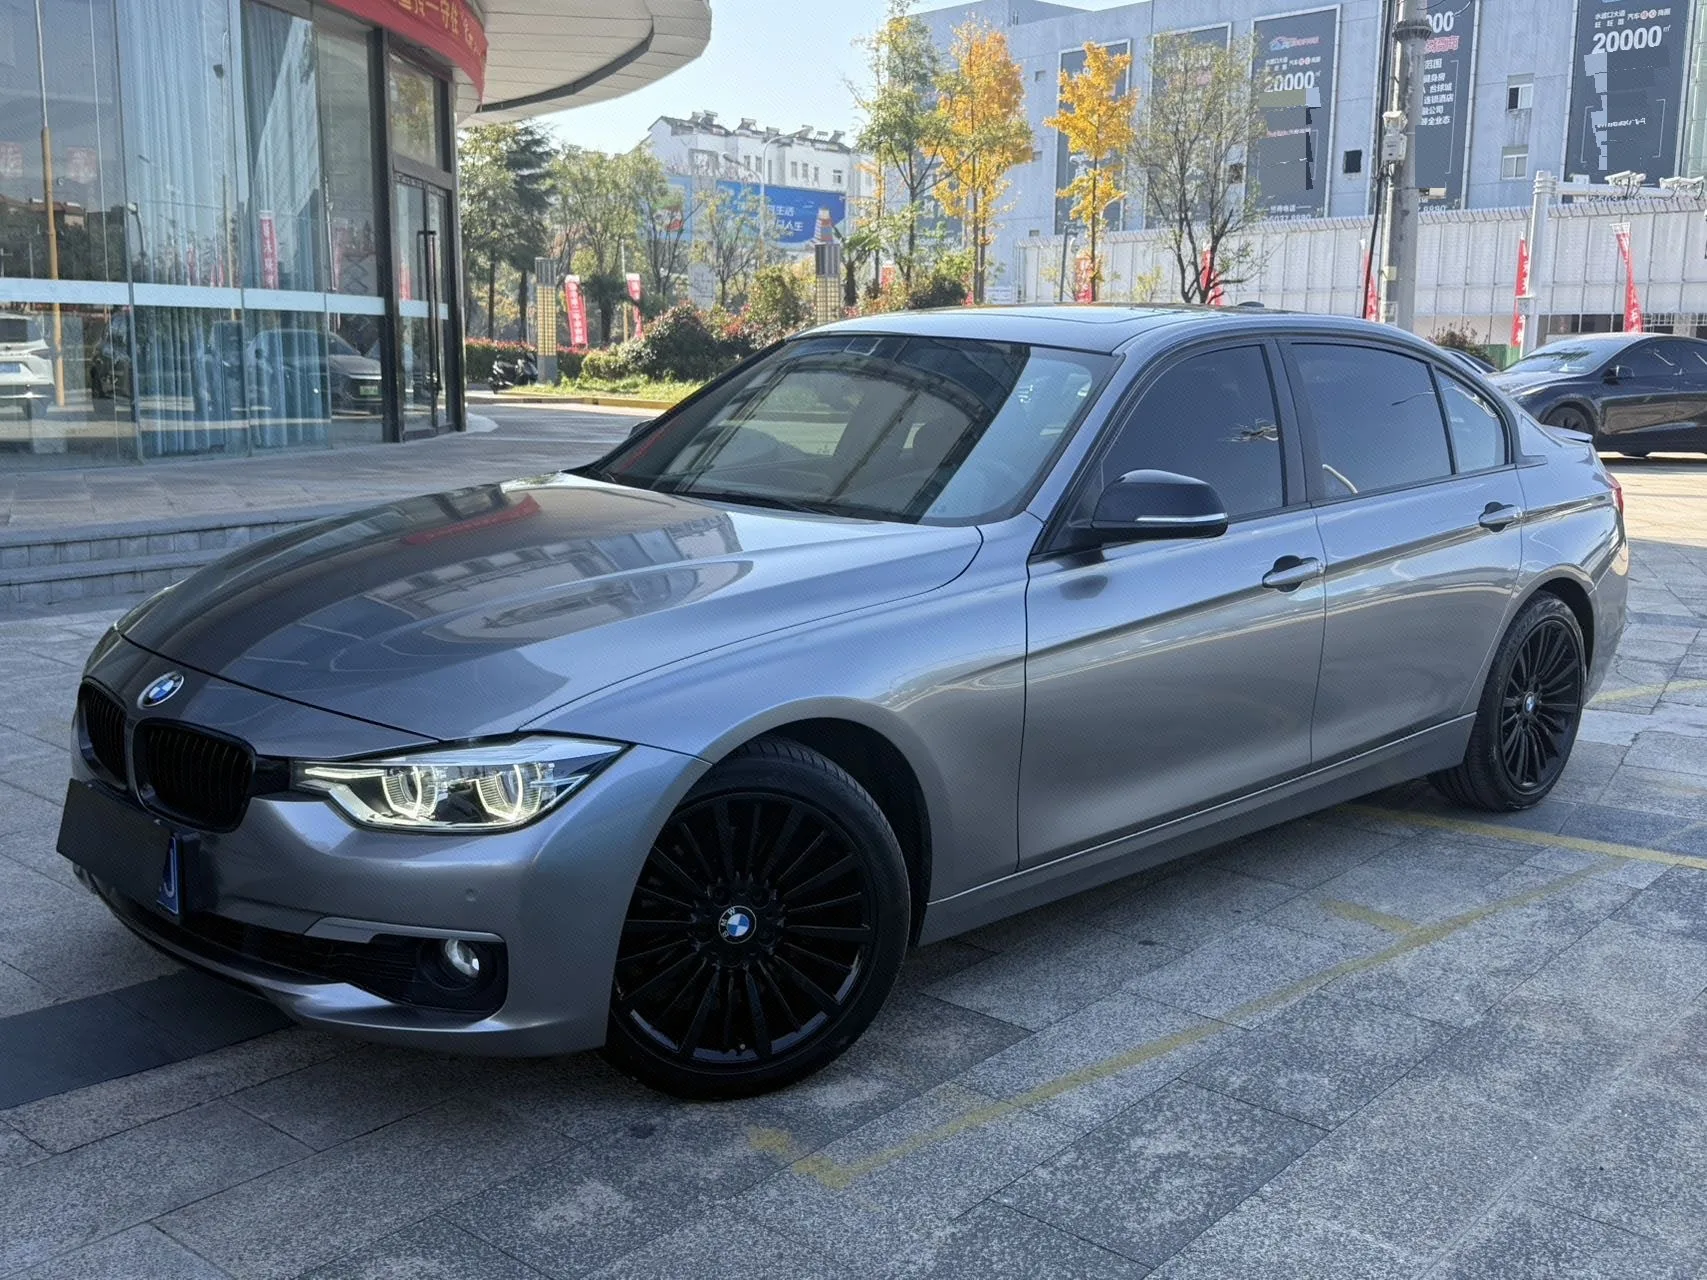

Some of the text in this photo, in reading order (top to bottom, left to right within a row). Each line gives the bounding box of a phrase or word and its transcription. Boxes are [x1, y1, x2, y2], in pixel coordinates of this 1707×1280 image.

[1591, 25, 1662, 54] 20000
[1264, 71, 1315, 92] 20000
[720, 907, 736, 938] BMW
